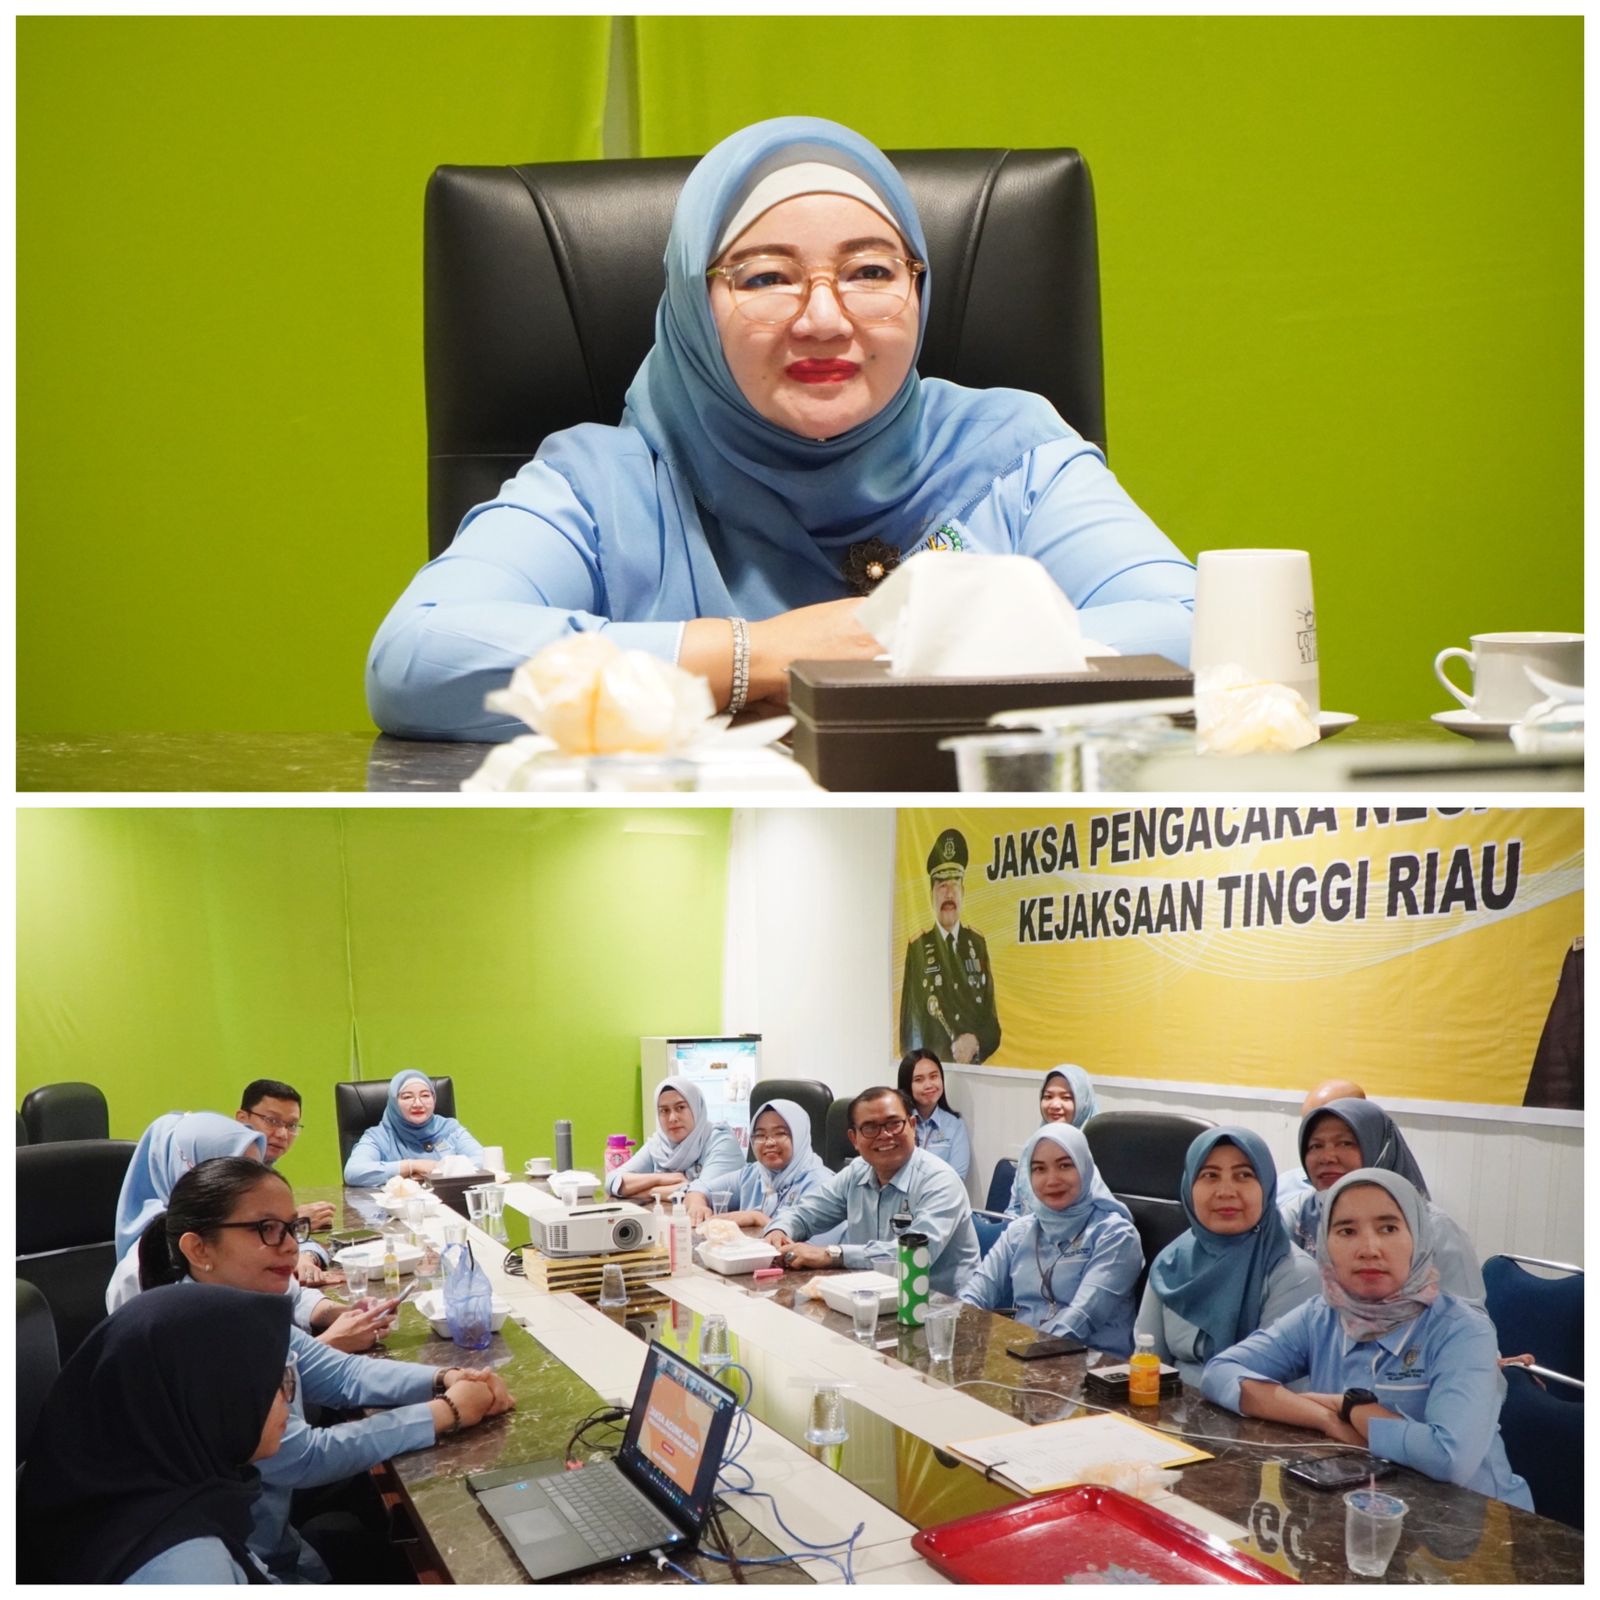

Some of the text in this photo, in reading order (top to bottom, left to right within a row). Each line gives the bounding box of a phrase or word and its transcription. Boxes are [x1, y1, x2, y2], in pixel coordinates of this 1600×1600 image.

[986, 823, 1079, 881] JAKSA
[1018, 841, 1521, 943] KEJAKSAAN TINGGI RIAU
